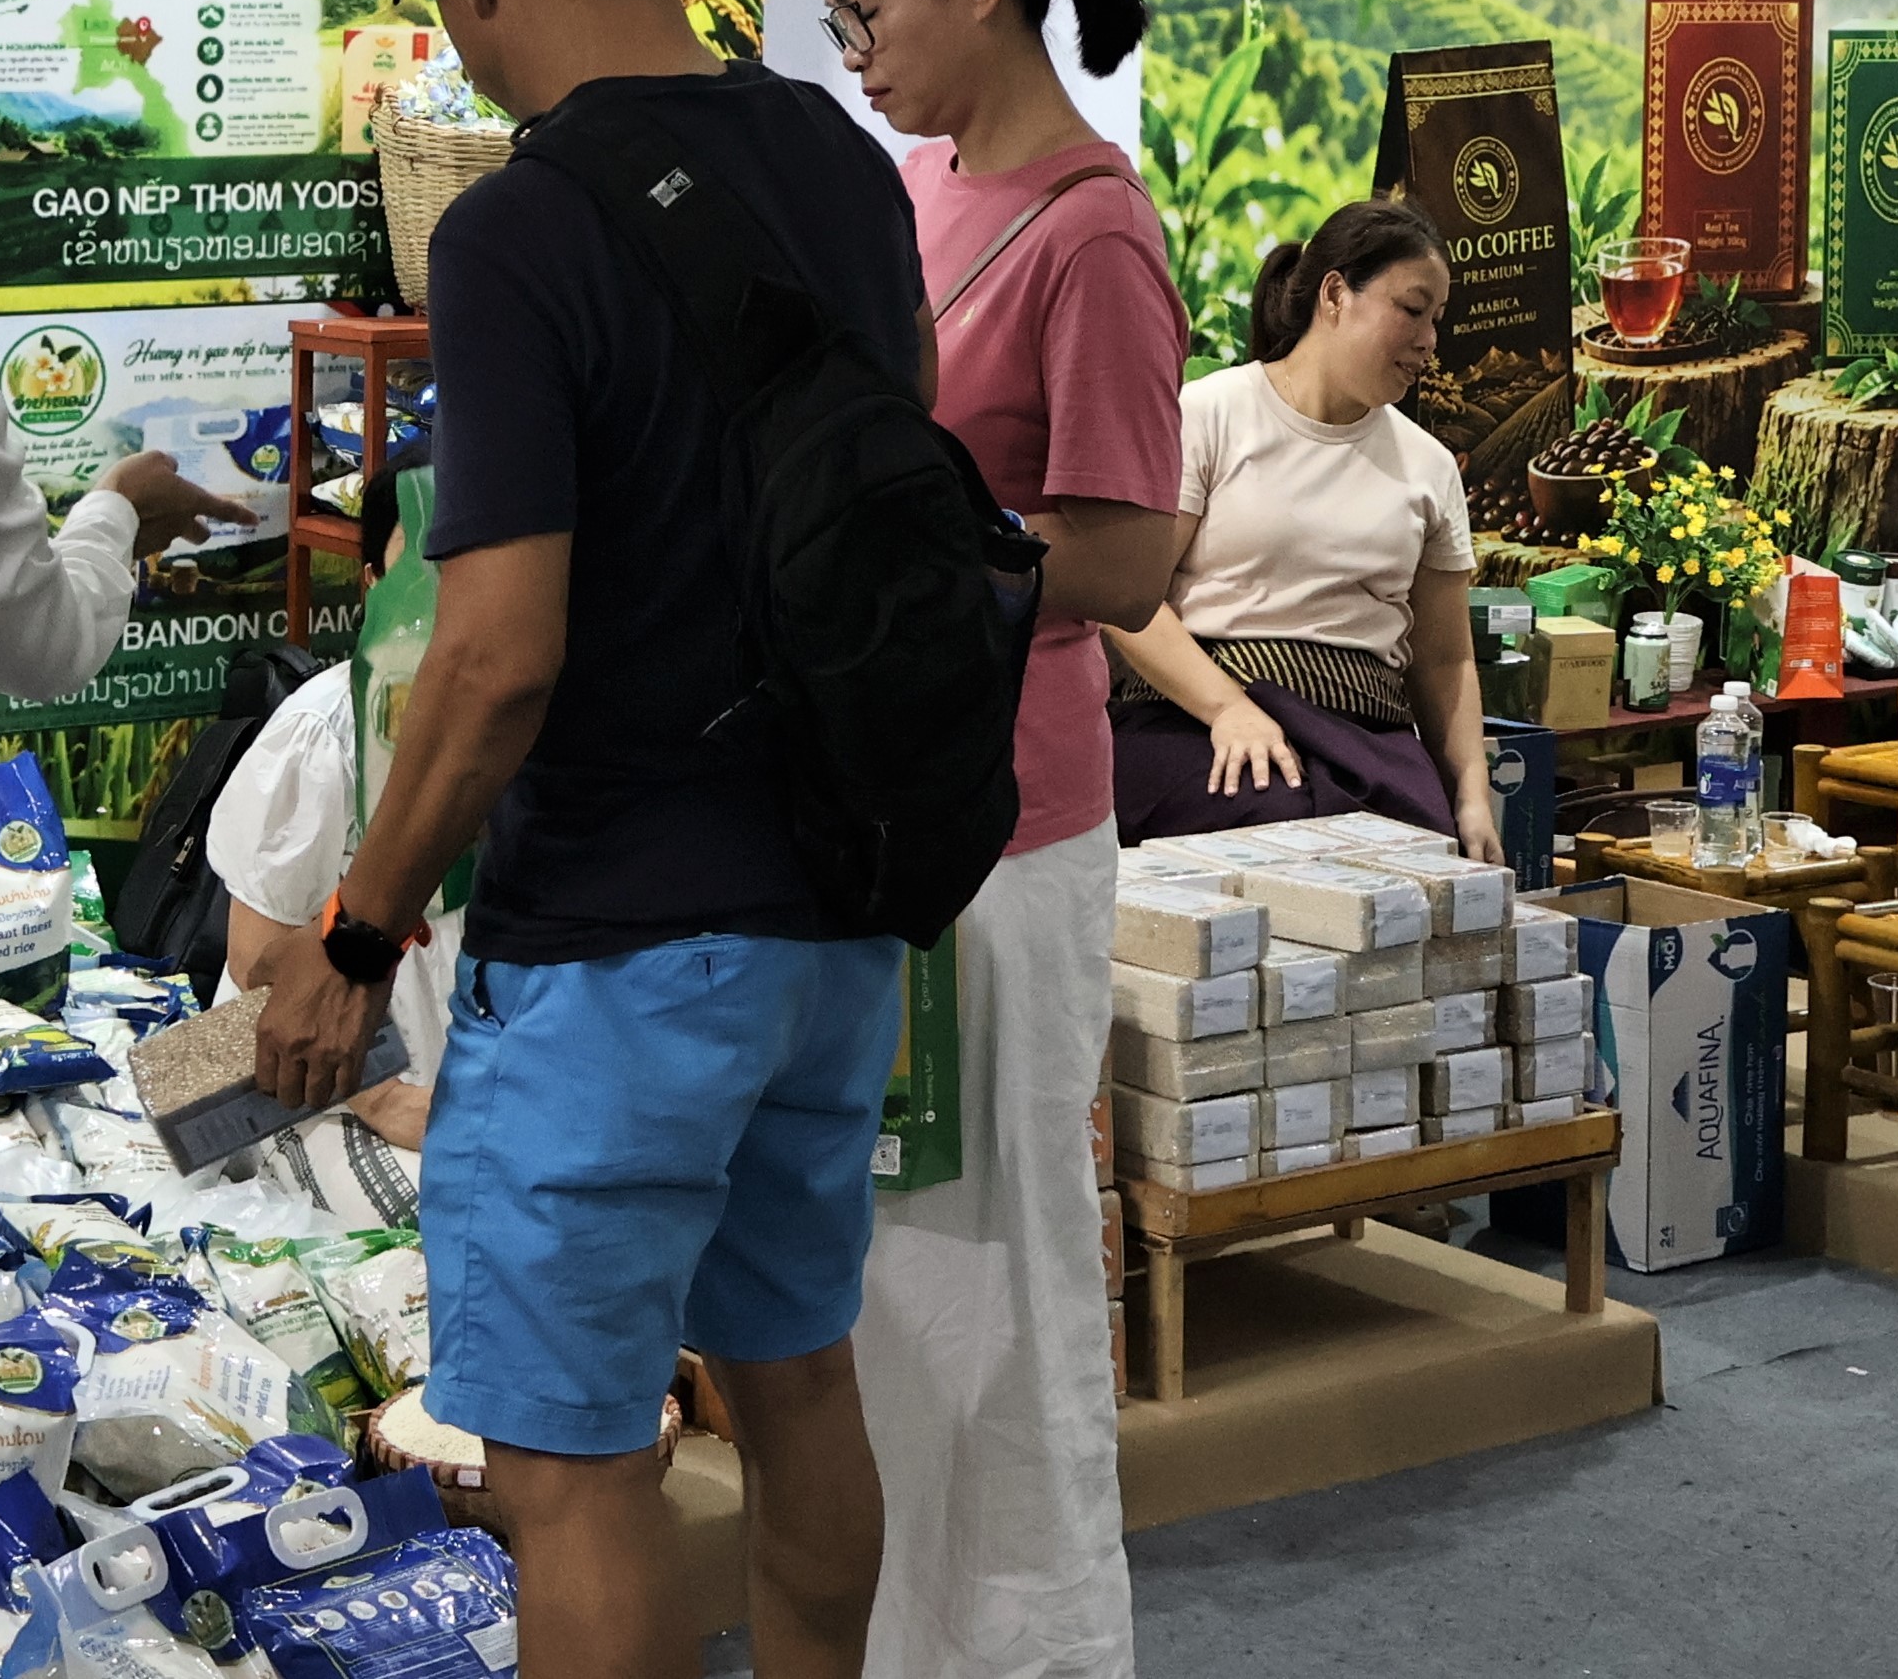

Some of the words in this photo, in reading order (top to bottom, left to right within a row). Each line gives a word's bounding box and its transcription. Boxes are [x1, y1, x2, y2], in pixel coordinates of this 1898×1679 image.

[33, 187, 110, 225] GẠO
[118, 176, 180, 215] NẾP
[190, 181, 283, 213] THƠM
[291, 180, 385, 209] YODS
[1477, 225, 1556, 259] COFFEE
[1463, 264, 1524, 285] PREMIUM
[1469, 297, 1520, 316] ARABICA
[122, 613, 260, 651] BANDON
[14, 942, 36, 955] rice
